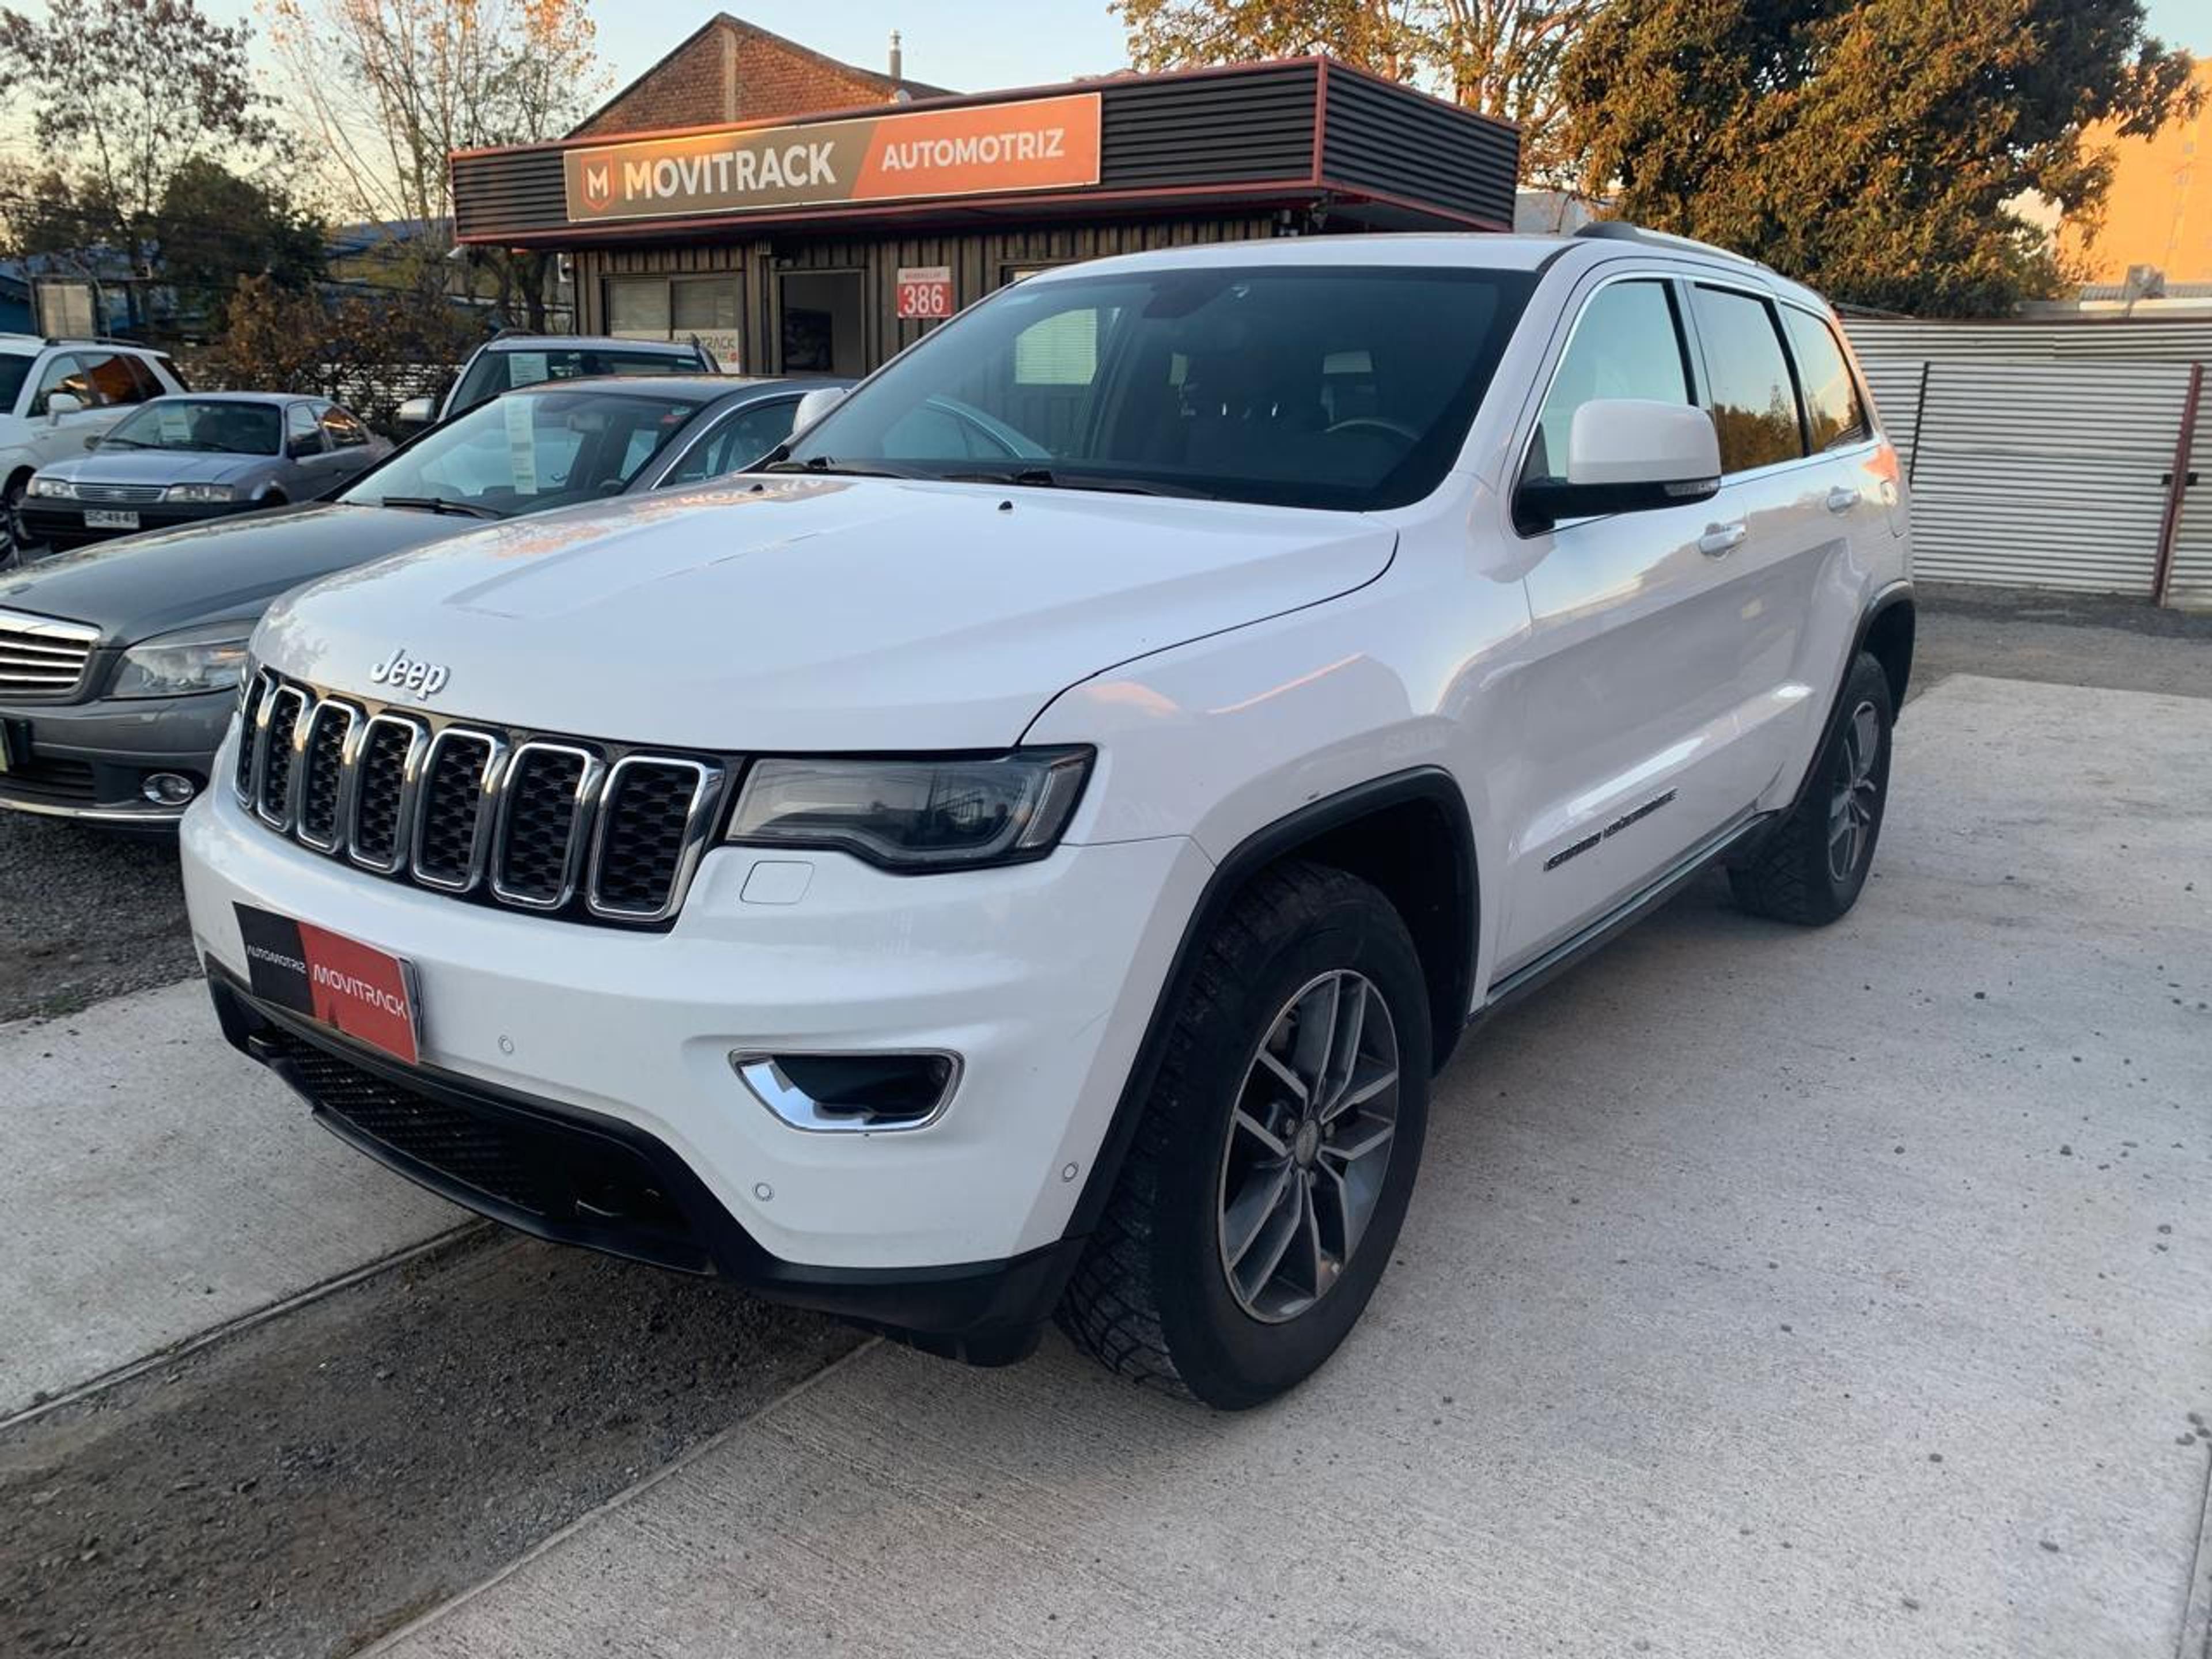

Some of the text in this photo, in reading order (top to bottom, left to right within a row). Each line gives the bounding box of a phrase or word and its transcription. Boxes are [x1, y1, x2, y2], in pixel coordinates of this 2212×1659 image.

[588, 165, 609, 199] M
[623, 127, 1065, 200] MOVITRACK AUTOMOTRIZ
[904, 285, 943, 313] 386
[372, 649, 450, 701] Jeep
[247, 945, 407, 1020] AUTOMOTRIZ MOVITRACK
